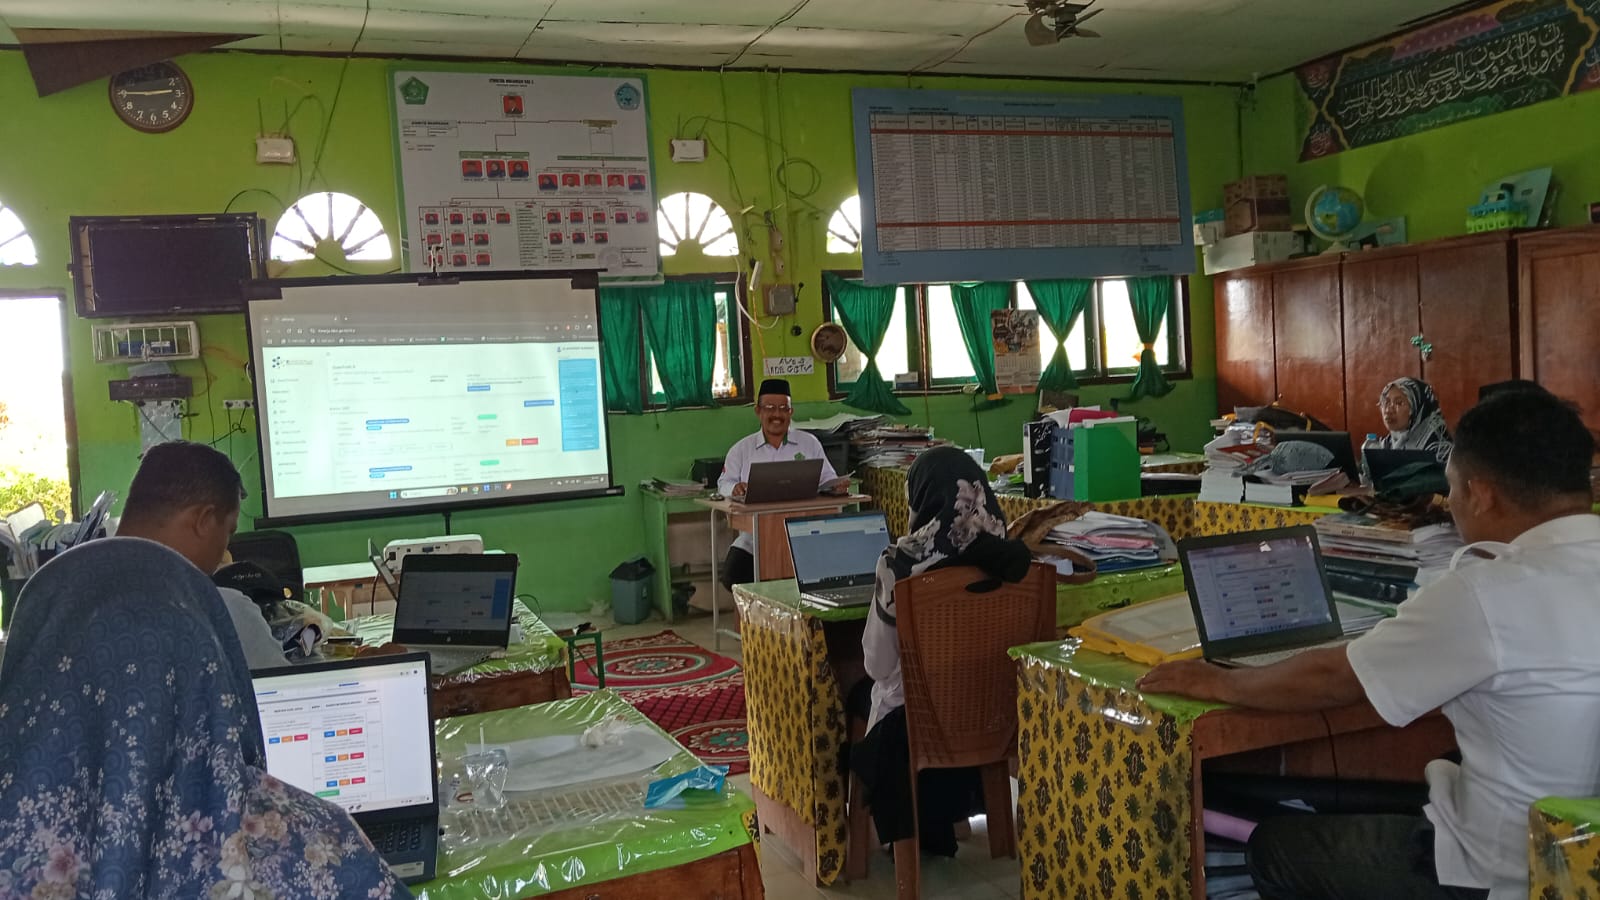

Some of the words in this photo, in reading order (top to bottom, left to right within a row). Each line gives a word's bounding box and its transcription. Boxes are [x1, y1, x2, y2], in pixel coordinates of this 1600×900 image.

[168, 77, 175, 86] 2
[175, 89, 181, 98] 3
[126, 101, 133, 110] 8
[171, 101, 177, 110] 4
[138, 111, 145, 119] 7
[150, 113, 157, 122] 6
[162, 110, 169, 119] 5
